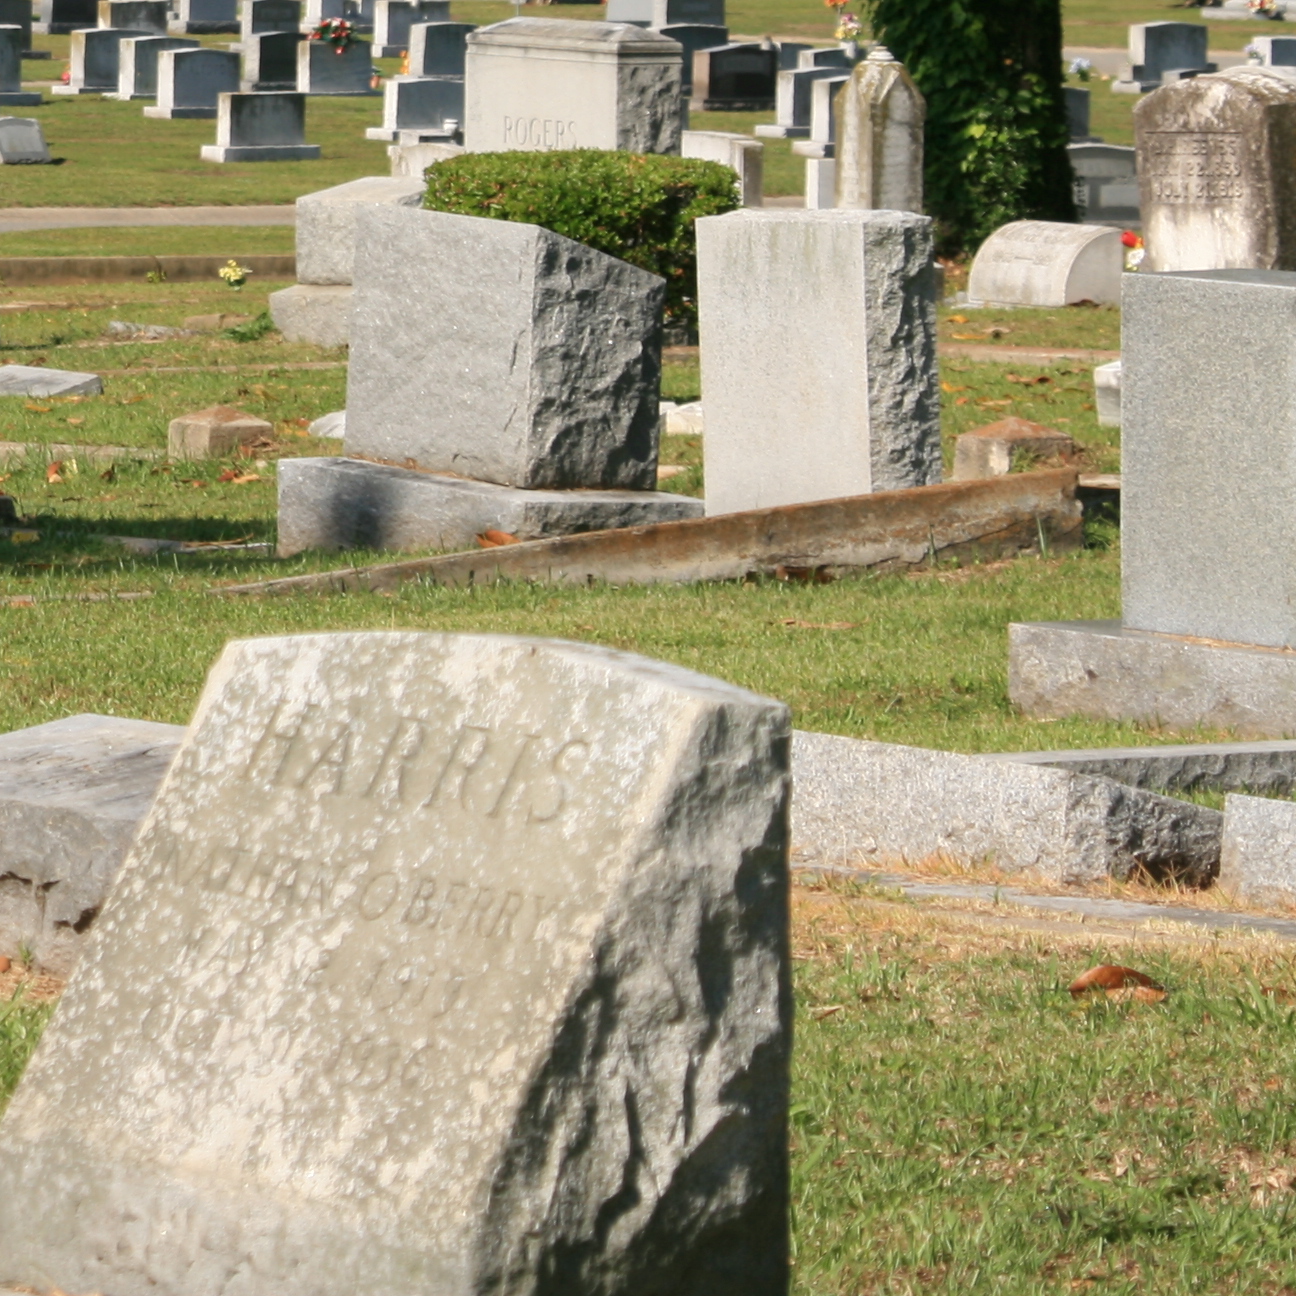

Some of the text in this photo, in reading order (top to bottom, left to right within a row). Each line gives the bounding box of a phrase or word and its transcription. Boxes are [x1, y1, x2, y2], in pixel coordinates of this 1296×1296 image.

[503, 115, 578, 149] ROGERS
[244, 696, 592, 825] HARRIS
[157, 837, 347, 913] NATHAN
